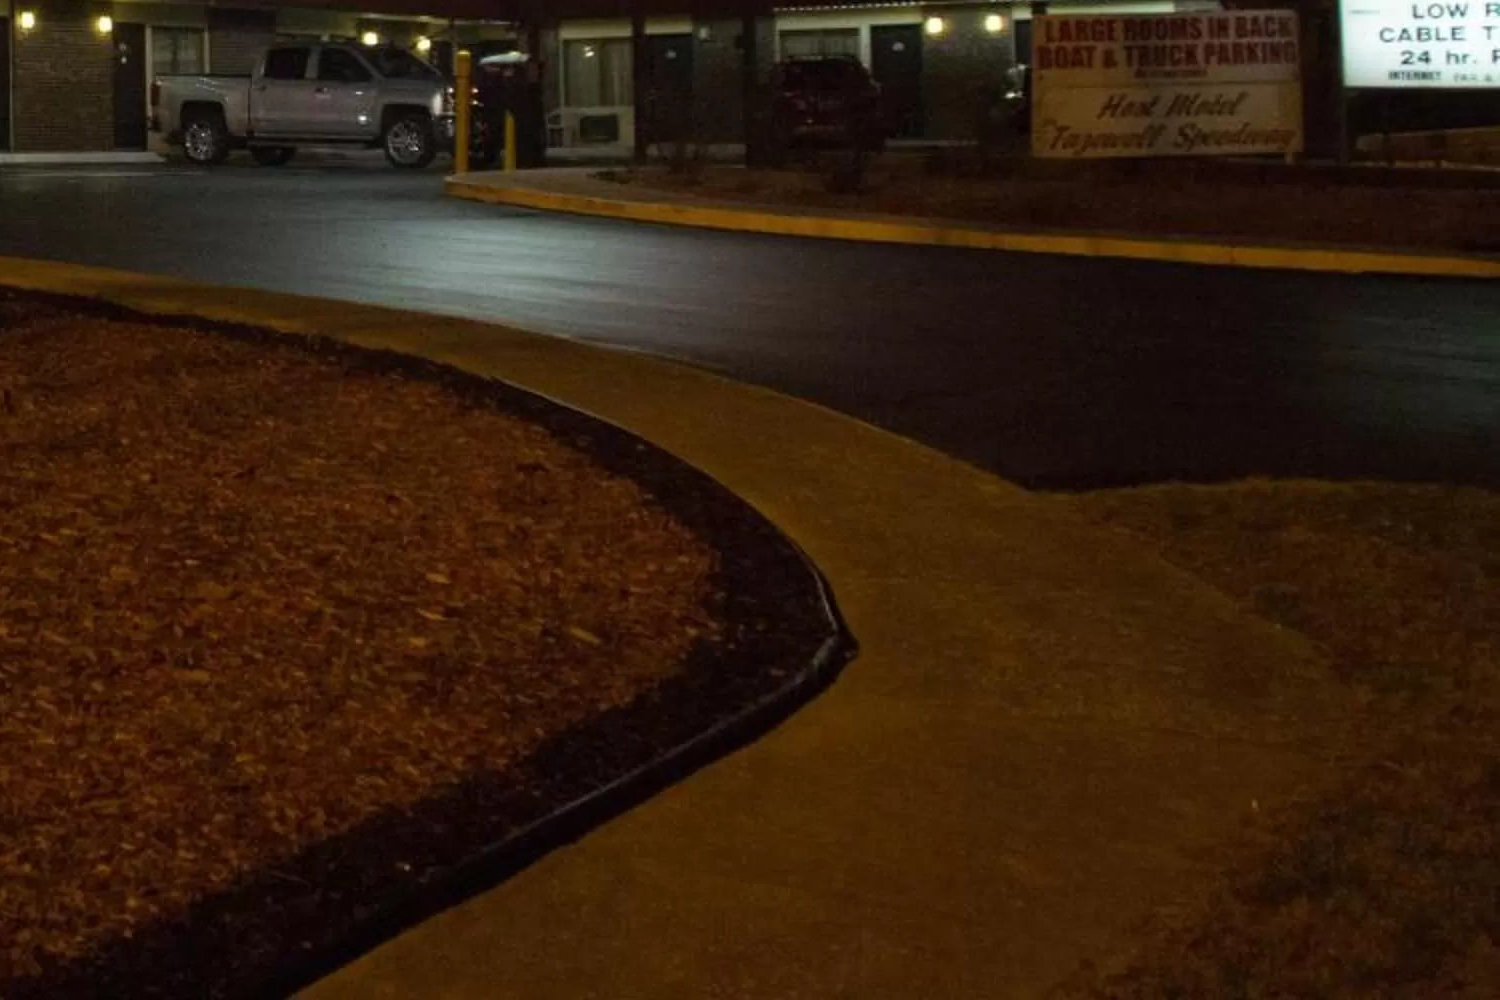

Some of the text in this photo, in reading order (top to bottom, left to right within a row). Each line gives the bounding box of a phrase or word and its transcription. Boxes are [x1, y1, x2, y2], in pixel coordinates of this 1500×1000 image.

[1411, 2, 1469, 19] LOW
[1045, 18, 1116, 43] LARGE
[1123, 17, 1202, 41] ROOMS
[1235, 15, 1293, 38] BACK
[1379, 25, 1466, 43] CABLE
[1037, 46, 1097, 70] BOAT
[1124, 45, 1199, 68] TRUCK
[1203, 40, 1297, 65] PARKING
[1400, 49, 1431, 65] 24
[1445, 49, 1477, 65] hr.
